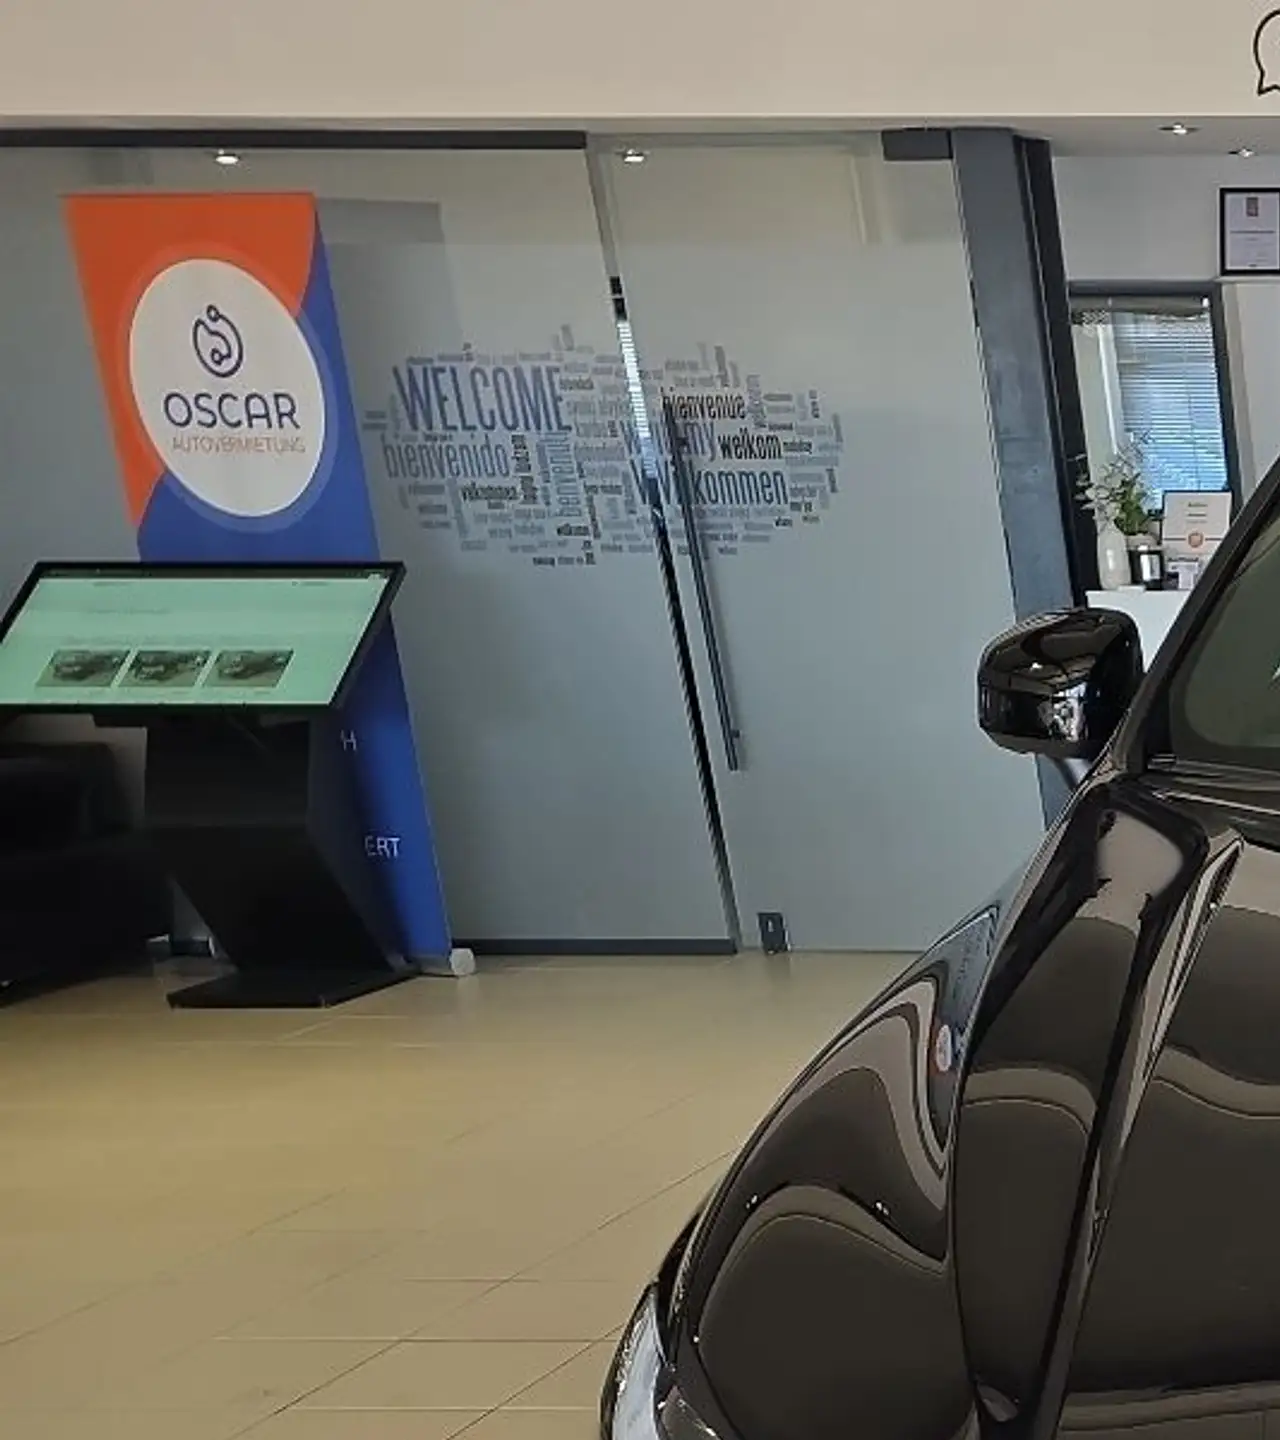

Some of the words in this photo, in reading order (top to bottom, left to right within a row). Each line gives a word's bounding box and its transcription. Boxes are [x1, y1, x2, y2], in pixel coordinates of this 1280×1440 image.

[164, 392, 301, 429] OSCAR
[393, 365, 572, 432] WELCOME
[660, 387, 746, 419] bienvenue
[381, 433, 511, 479] bienvenido
